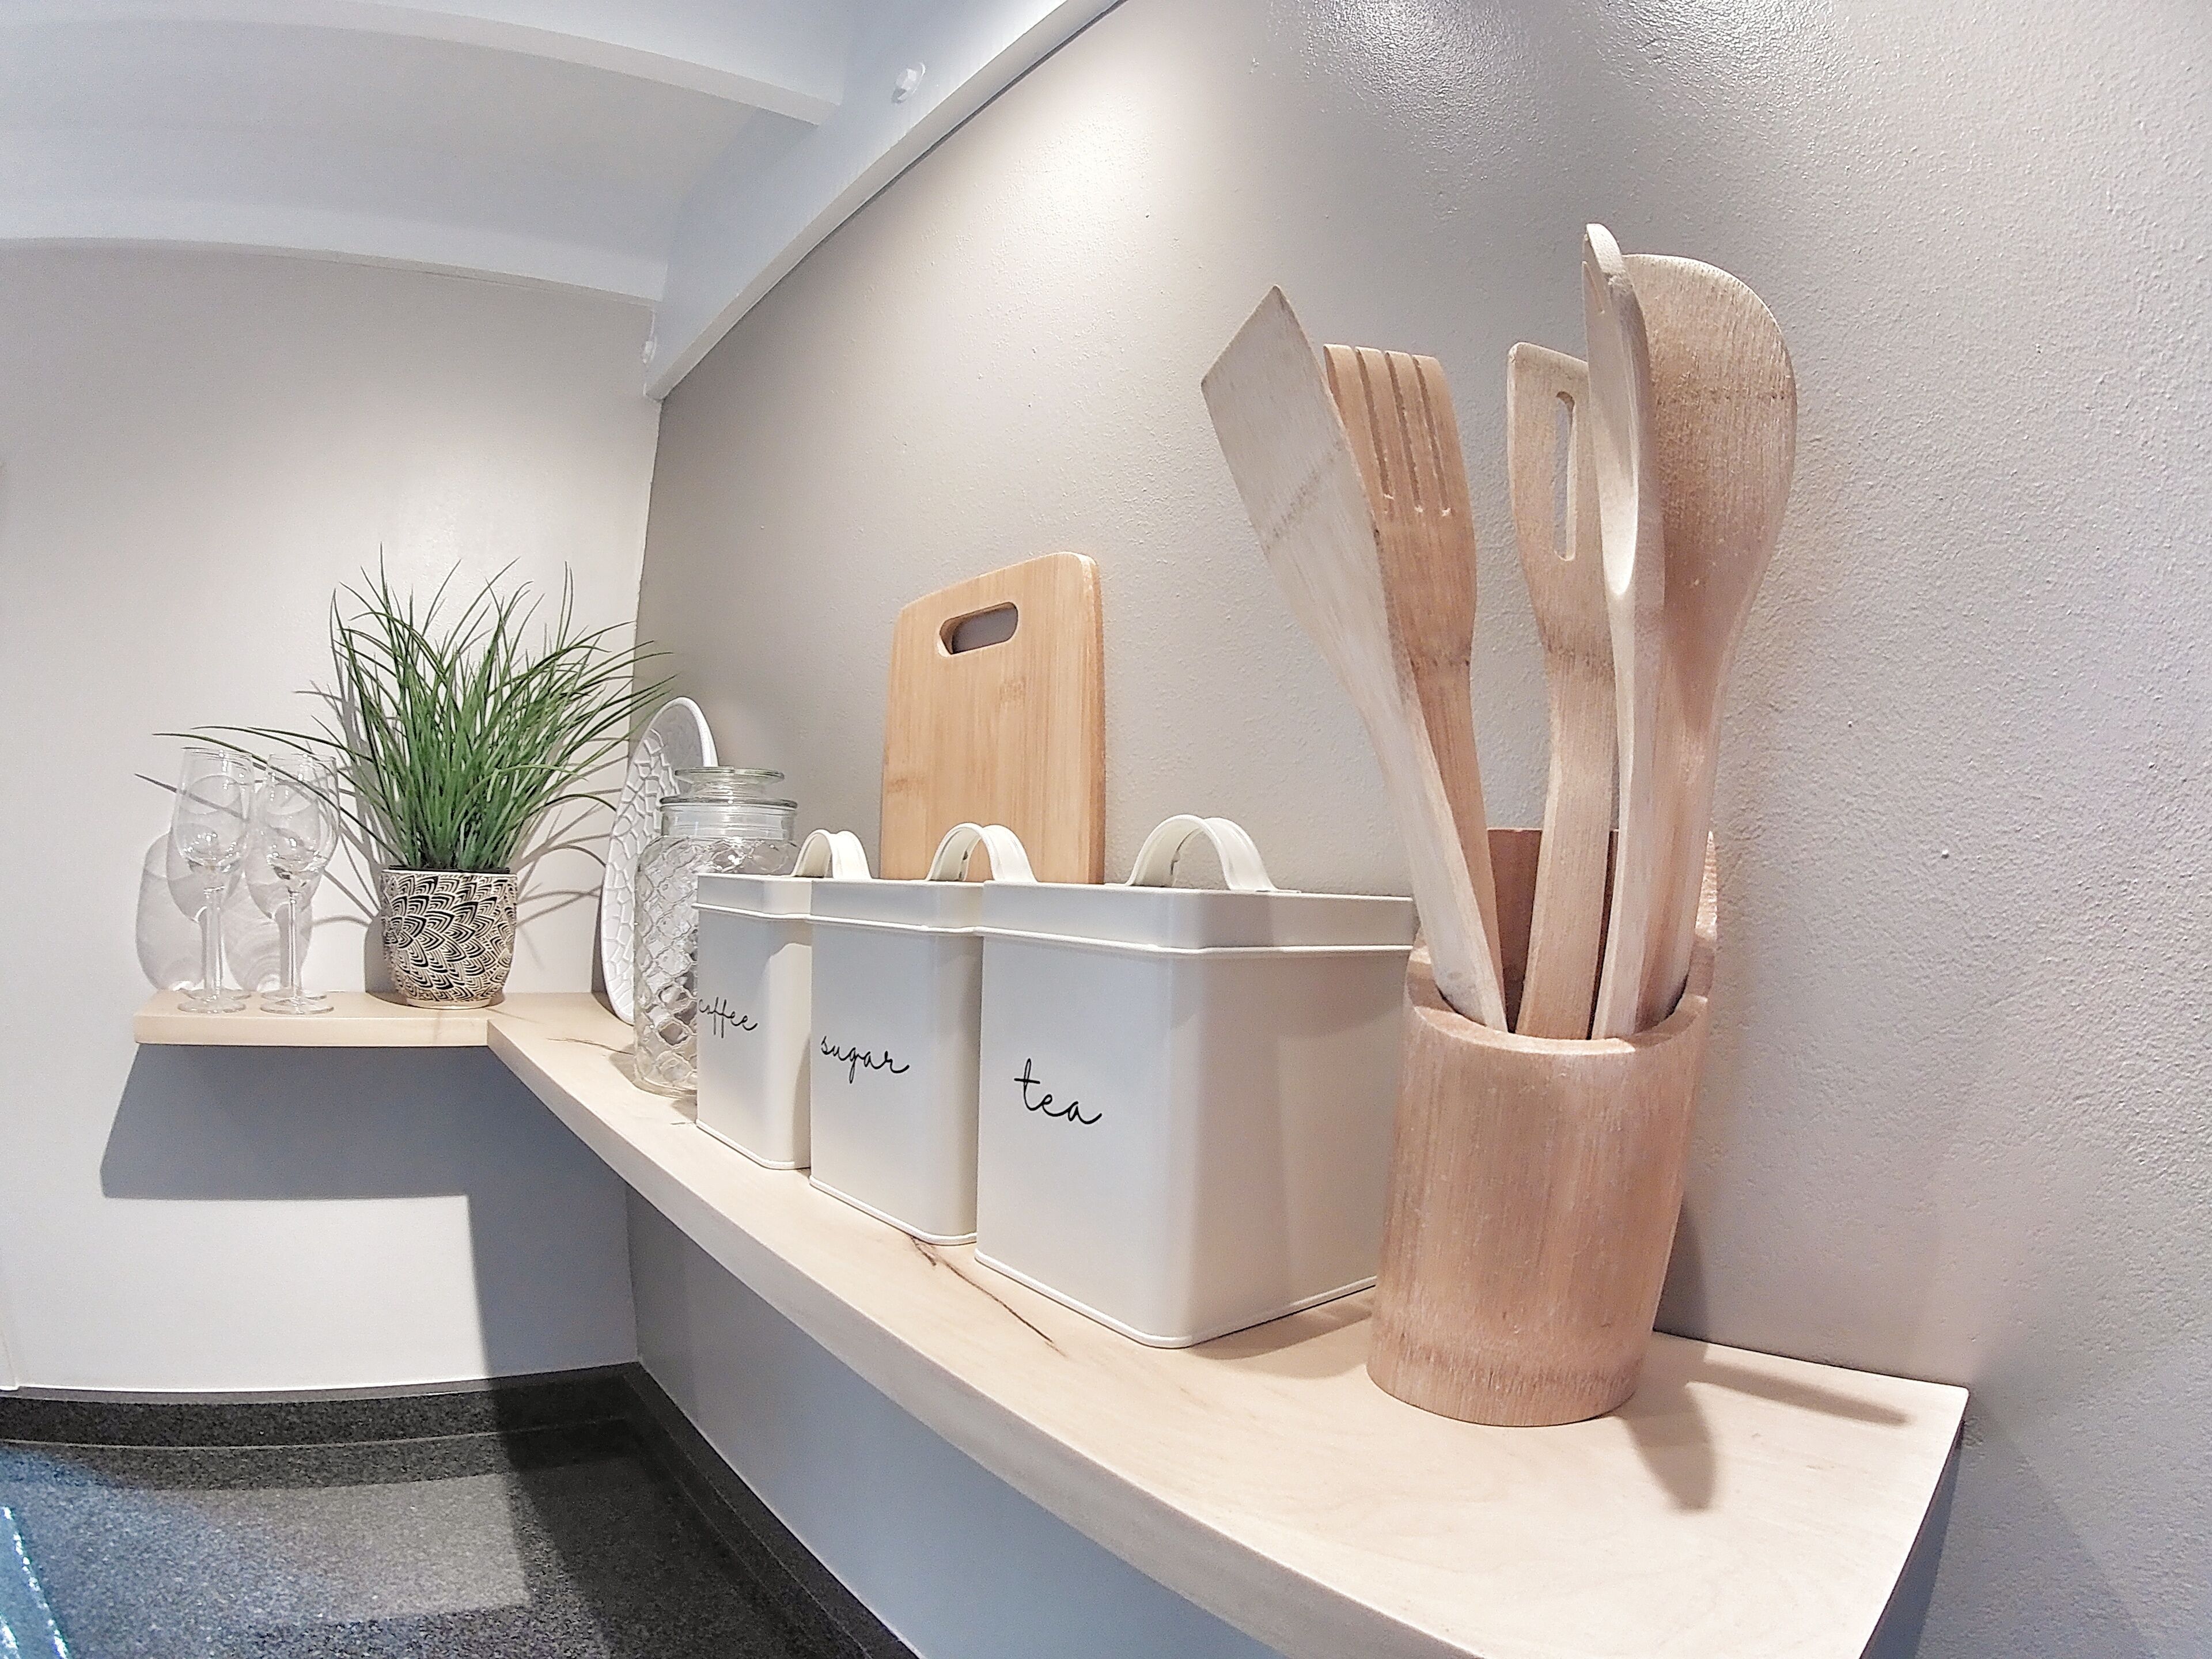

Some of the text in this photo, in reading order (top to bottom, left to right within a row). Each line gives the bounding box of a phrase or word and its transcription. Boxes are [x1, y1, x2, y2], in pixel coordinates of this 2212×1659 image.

[698, 996, 758, 1039] coffee
[821, 1036, 910, 1084] sugar
[1014, 1058, 1102, 1124] tea
